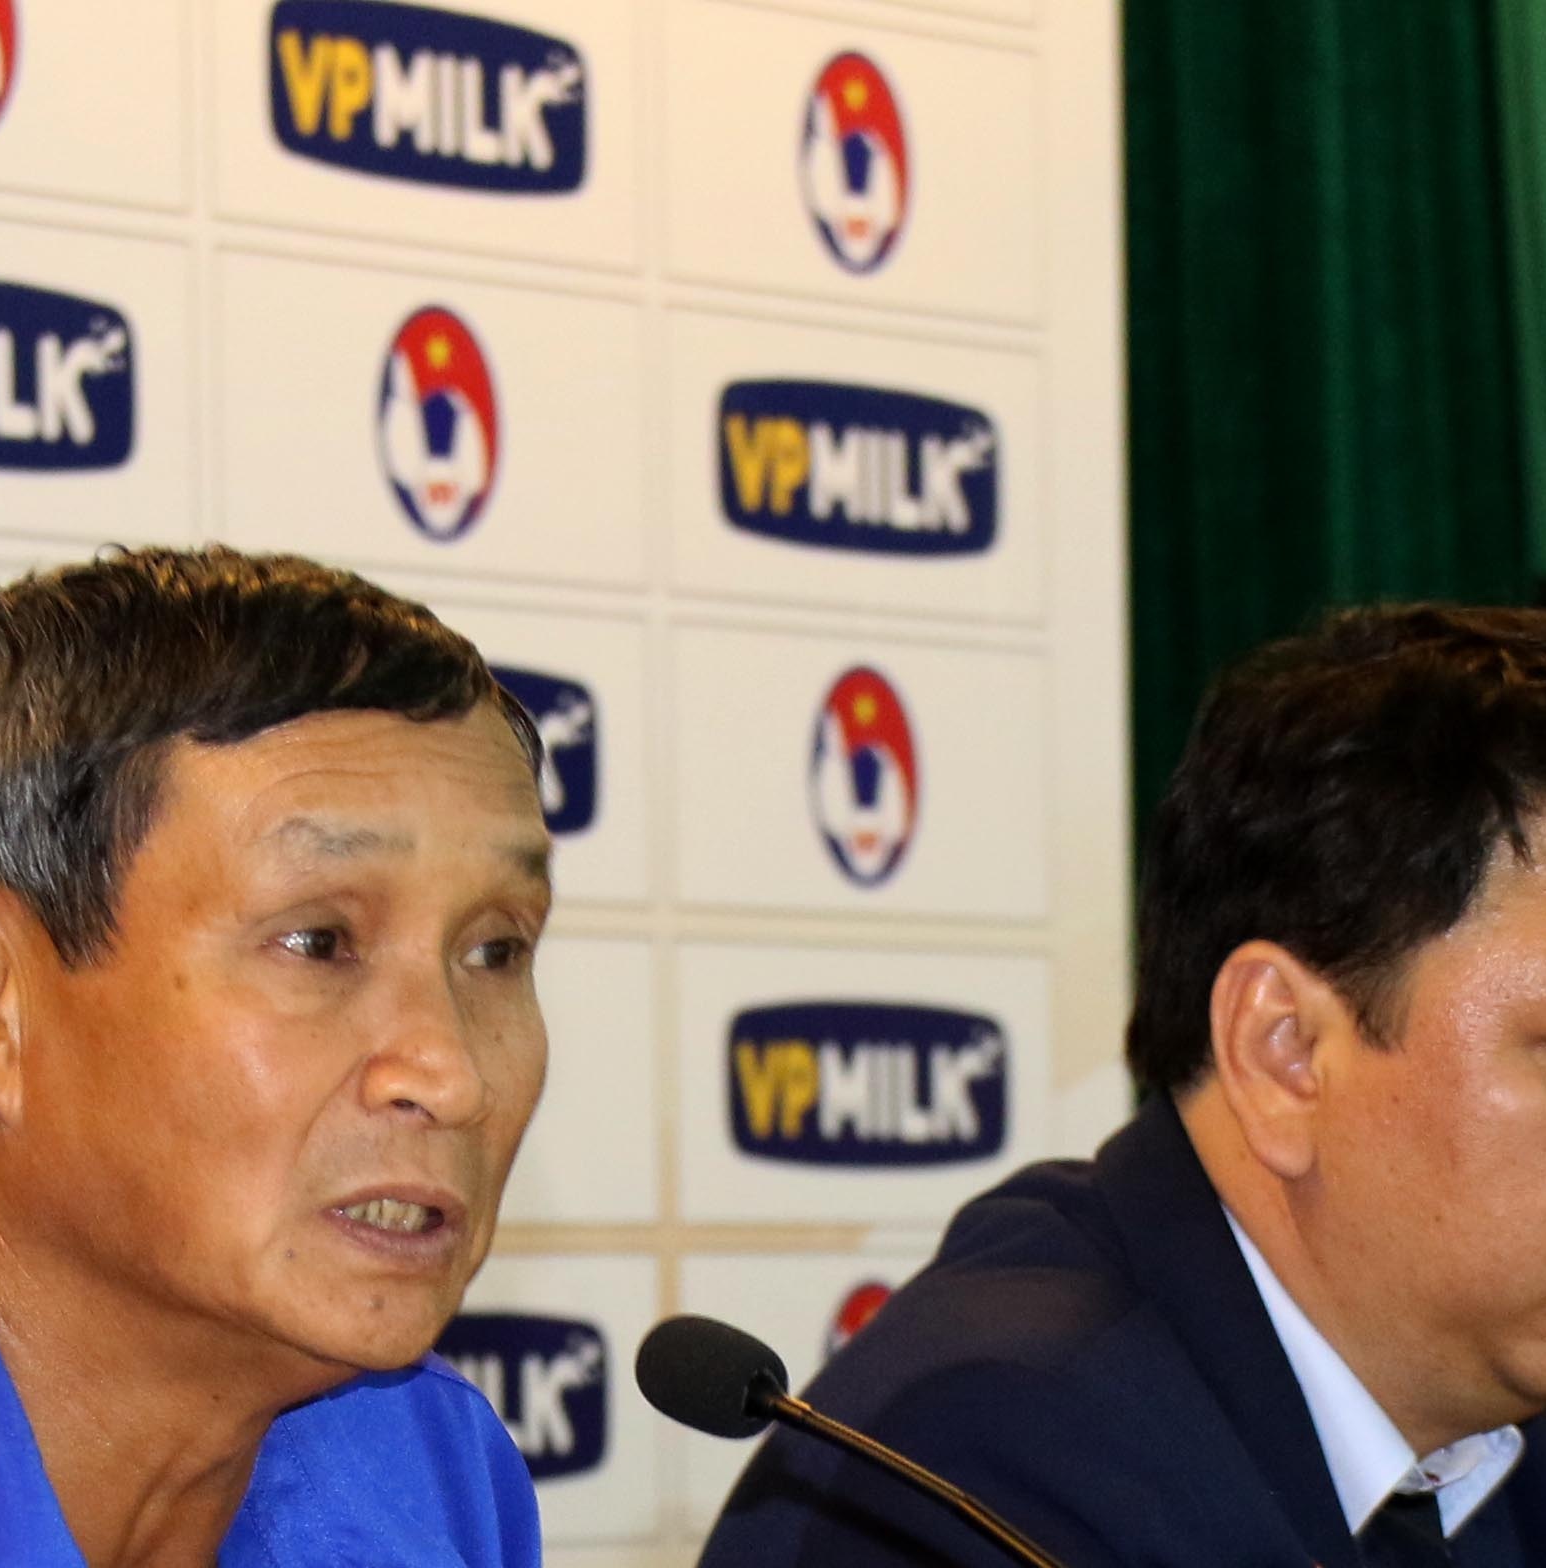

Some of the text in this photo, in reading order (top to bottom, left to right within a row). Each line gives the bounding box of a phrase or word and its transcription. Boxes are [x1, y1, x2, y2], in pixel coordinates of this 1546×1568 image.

[278, 30, 581, 170] VPMILK
[726, 412, 993, 533] VPMILK
[735, 1037, 1002, 1141] VPMILK
